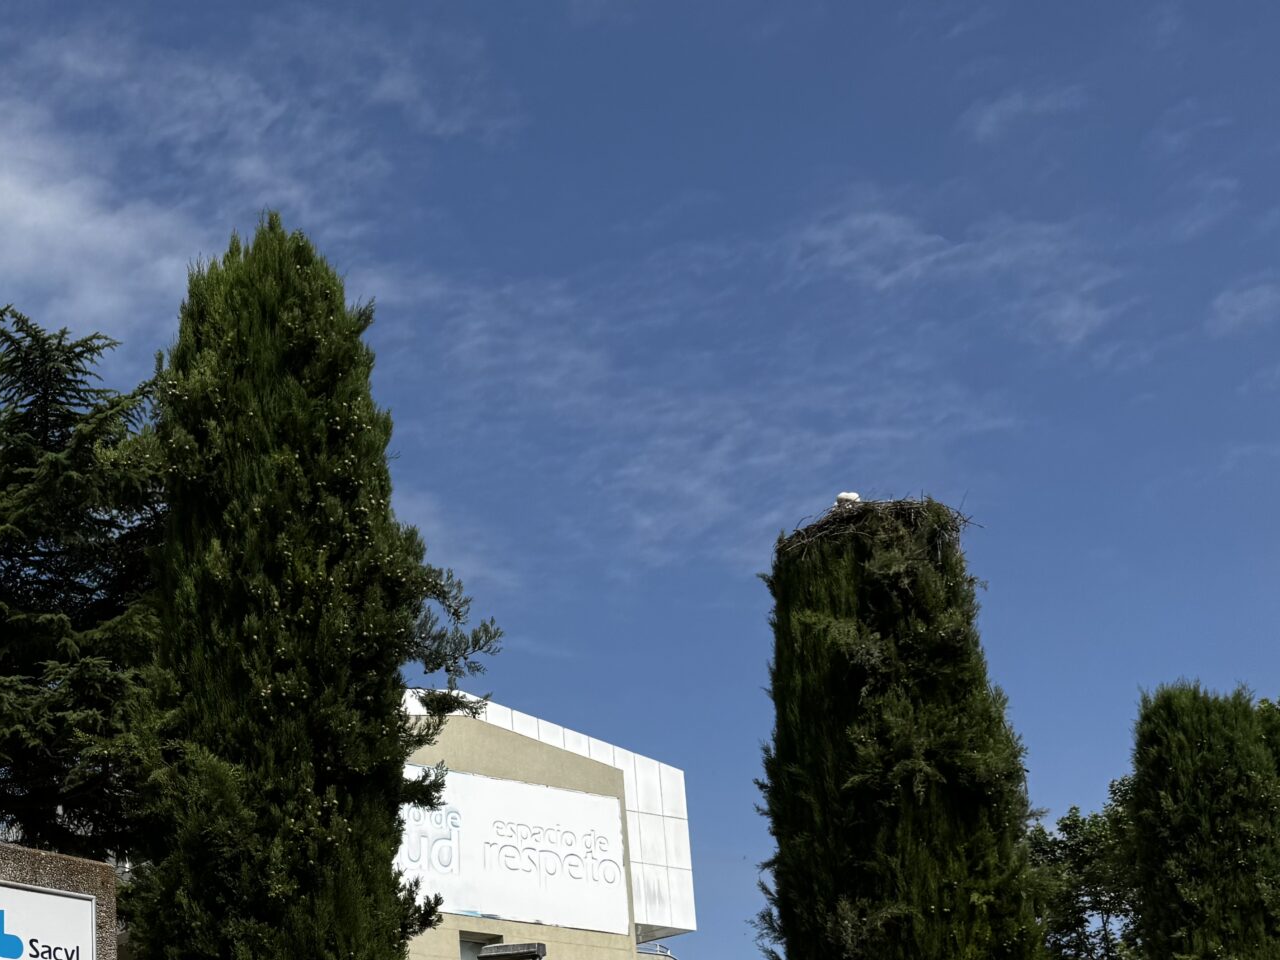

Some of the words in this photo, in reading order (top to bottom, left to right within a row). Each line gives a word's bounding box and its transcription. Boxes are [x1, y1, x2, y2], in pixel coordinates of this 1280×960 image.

[492, 820, 577, 847] espacio
[582, 829, 609, 852] de
[483, 841, 622, 888] respeto
